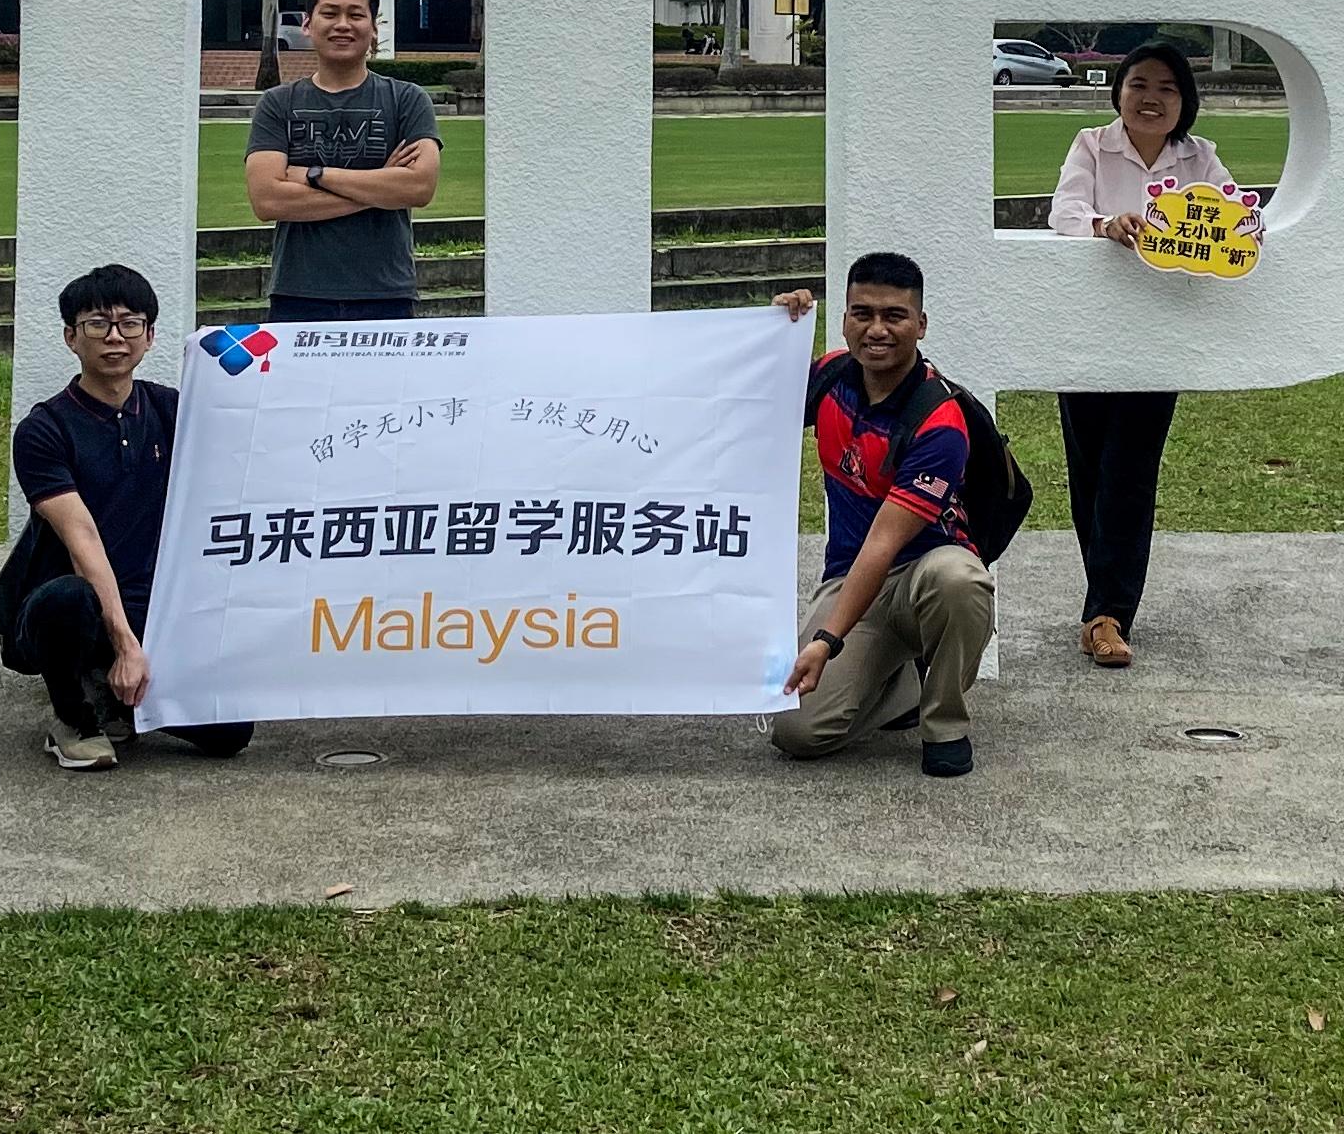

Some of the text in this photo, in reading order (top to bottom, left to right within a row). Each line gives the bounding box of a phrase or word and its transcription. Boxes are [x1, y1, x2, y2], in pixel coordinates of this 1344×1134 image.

[287, 119, 386, 142] BRAVE
[1186, 203, 1221, 224] 留学
[1175, 220, 1227, 243] 无小事
[293, 330, 470, 348] 新马国际教育
[309, 397, 659, 463] 留学无小事 当然更用心
[201, 498, 752, 566] 马来西亚留学服务站
[310, 591, 621, 664] Malaysia
